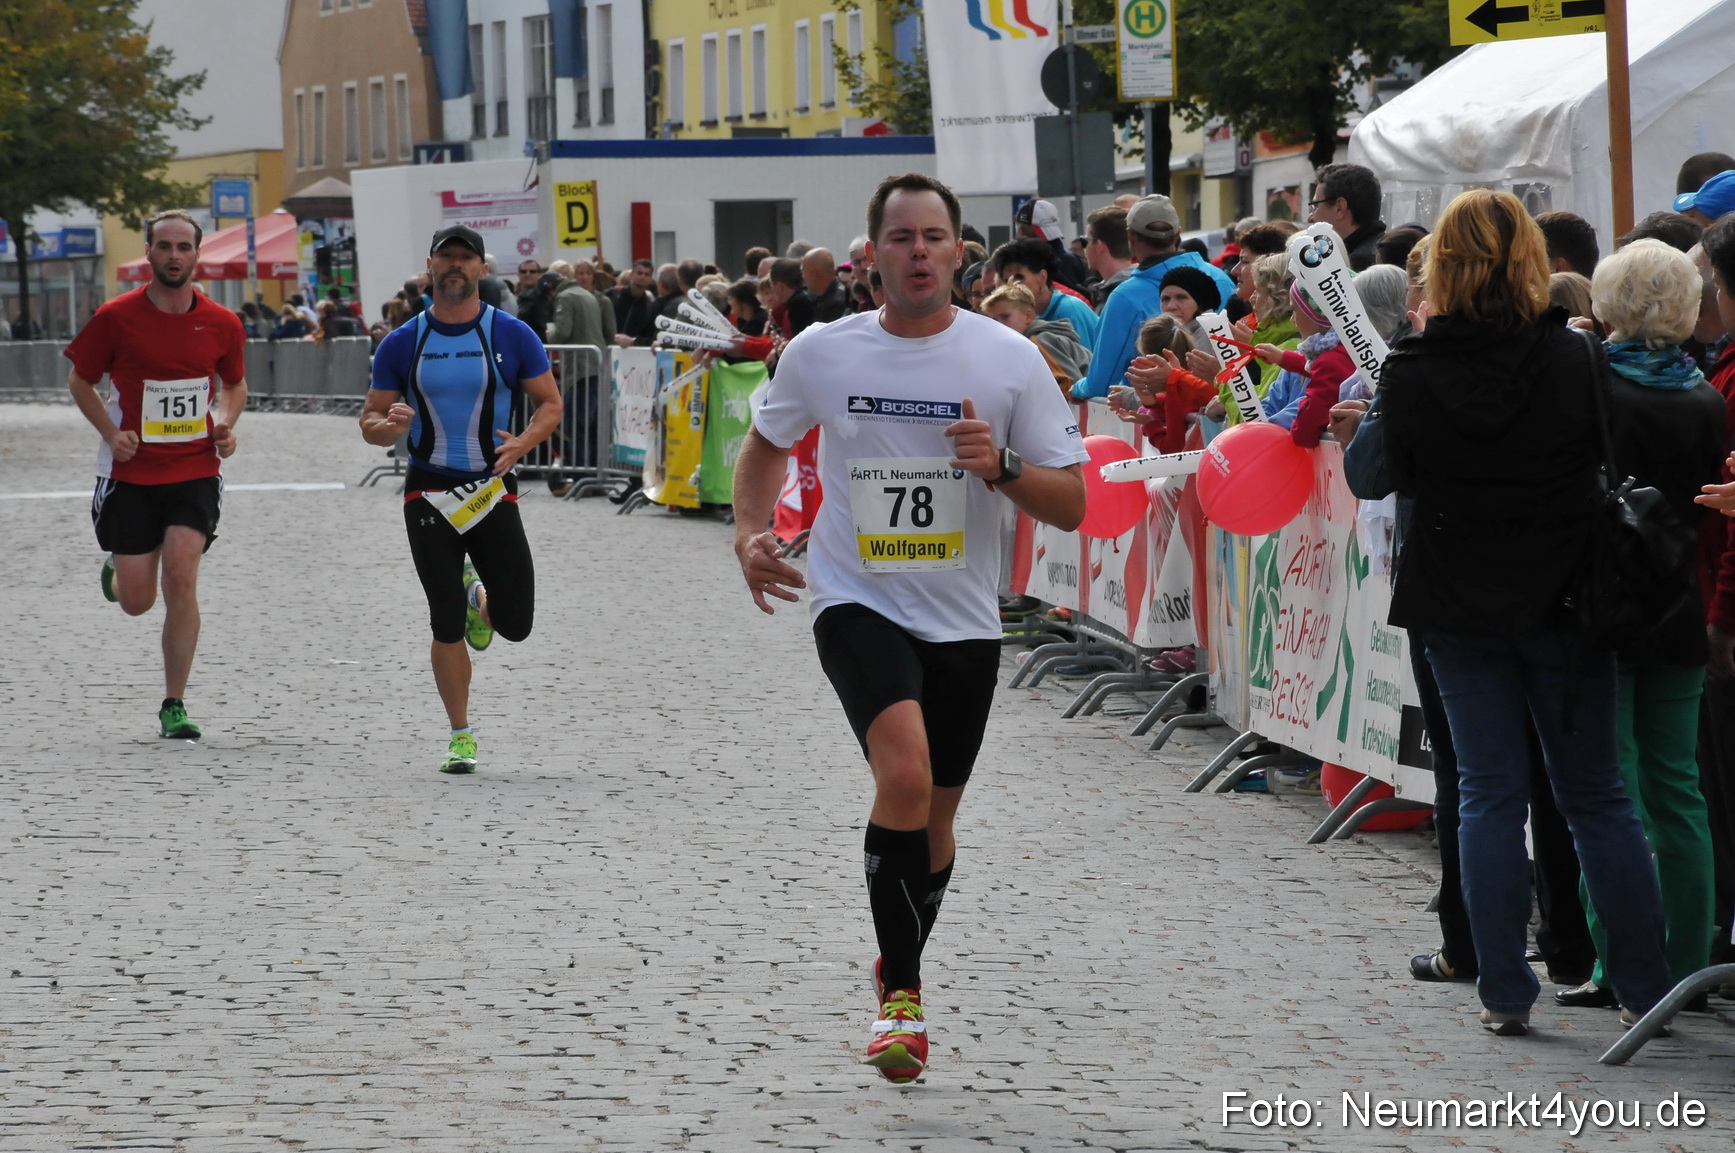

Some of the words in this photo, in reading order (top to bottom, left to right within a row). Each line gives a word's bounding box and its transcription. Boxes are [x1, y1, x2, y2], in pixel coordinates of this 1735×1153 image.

[558, 184, 593, 197] Block
[566, 201, 589, 233] D
[675, 323, 698, 336] BMW
[1318, 274, 1381, 385] bmw-laufspo
[678, 338, 701, 348] BMW
[170, 385, 201, 393] Neumarkt
[158, 394, 197, 418] 151
[881, 401, 956, 416] BÜSCHEL
[847, 414, 911, 424] FEINSCHNEIDTECHNIK
[163, 424, 193, 434] Martin
[890, 469, 948, 480] Neumarkt
[467, 490, 493, 513] Volker
[883, 486, 934, 528] 78
[870, 540, 946, 560] Wolfgang
